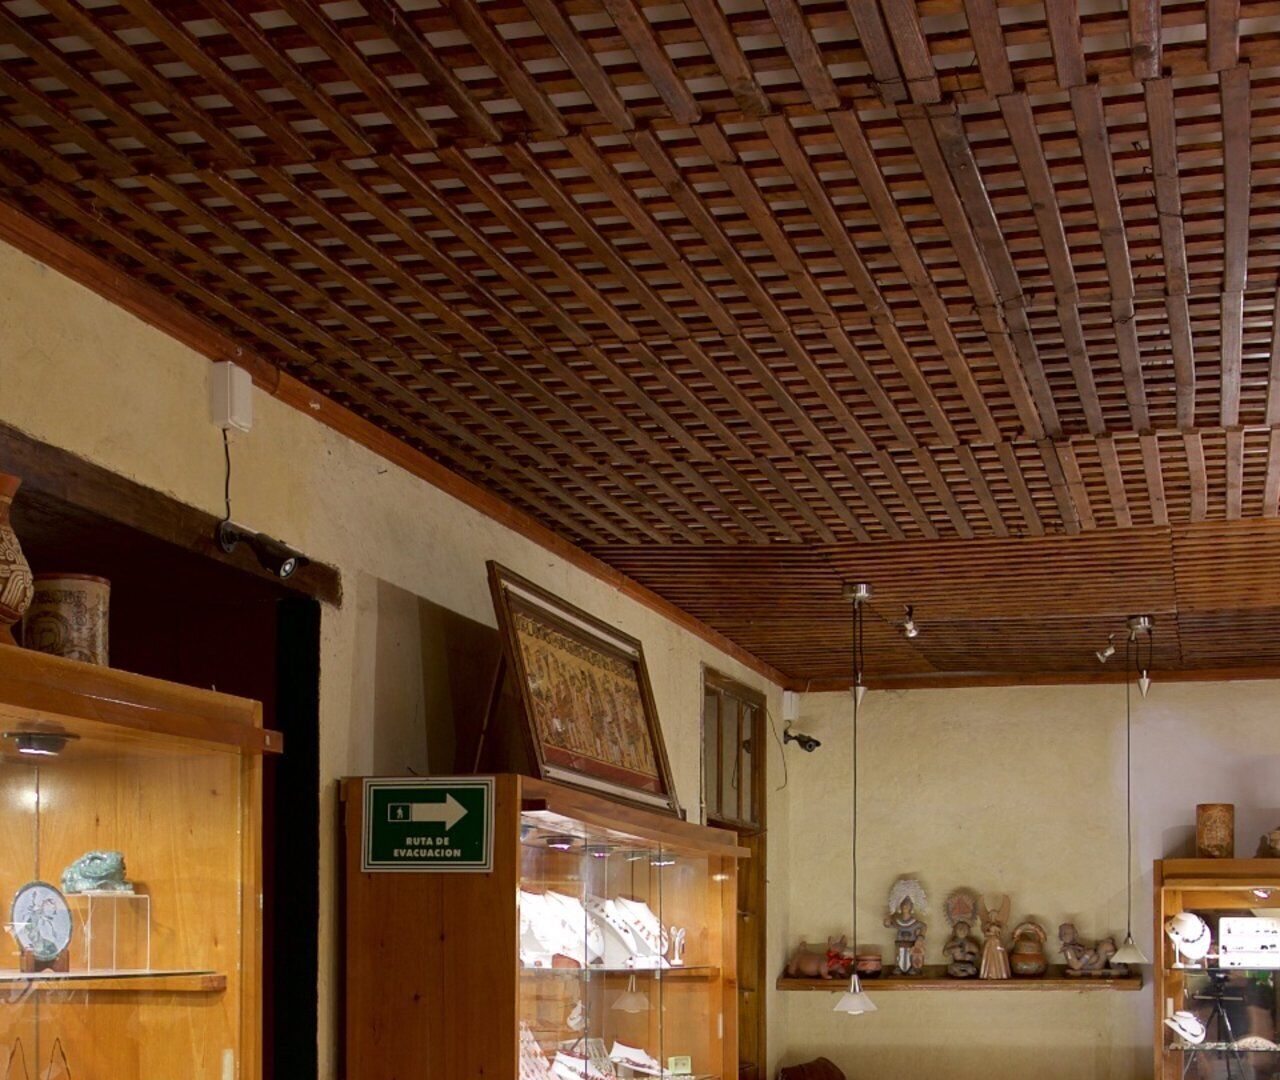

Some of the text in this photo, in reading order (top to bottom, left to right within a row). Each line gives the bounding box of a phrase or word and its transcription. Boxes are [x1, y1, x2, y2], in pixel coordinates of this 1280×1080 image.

[406, 837, 450, 846] RUTA DE
[393, 848, 462, 857] EVACUACION
